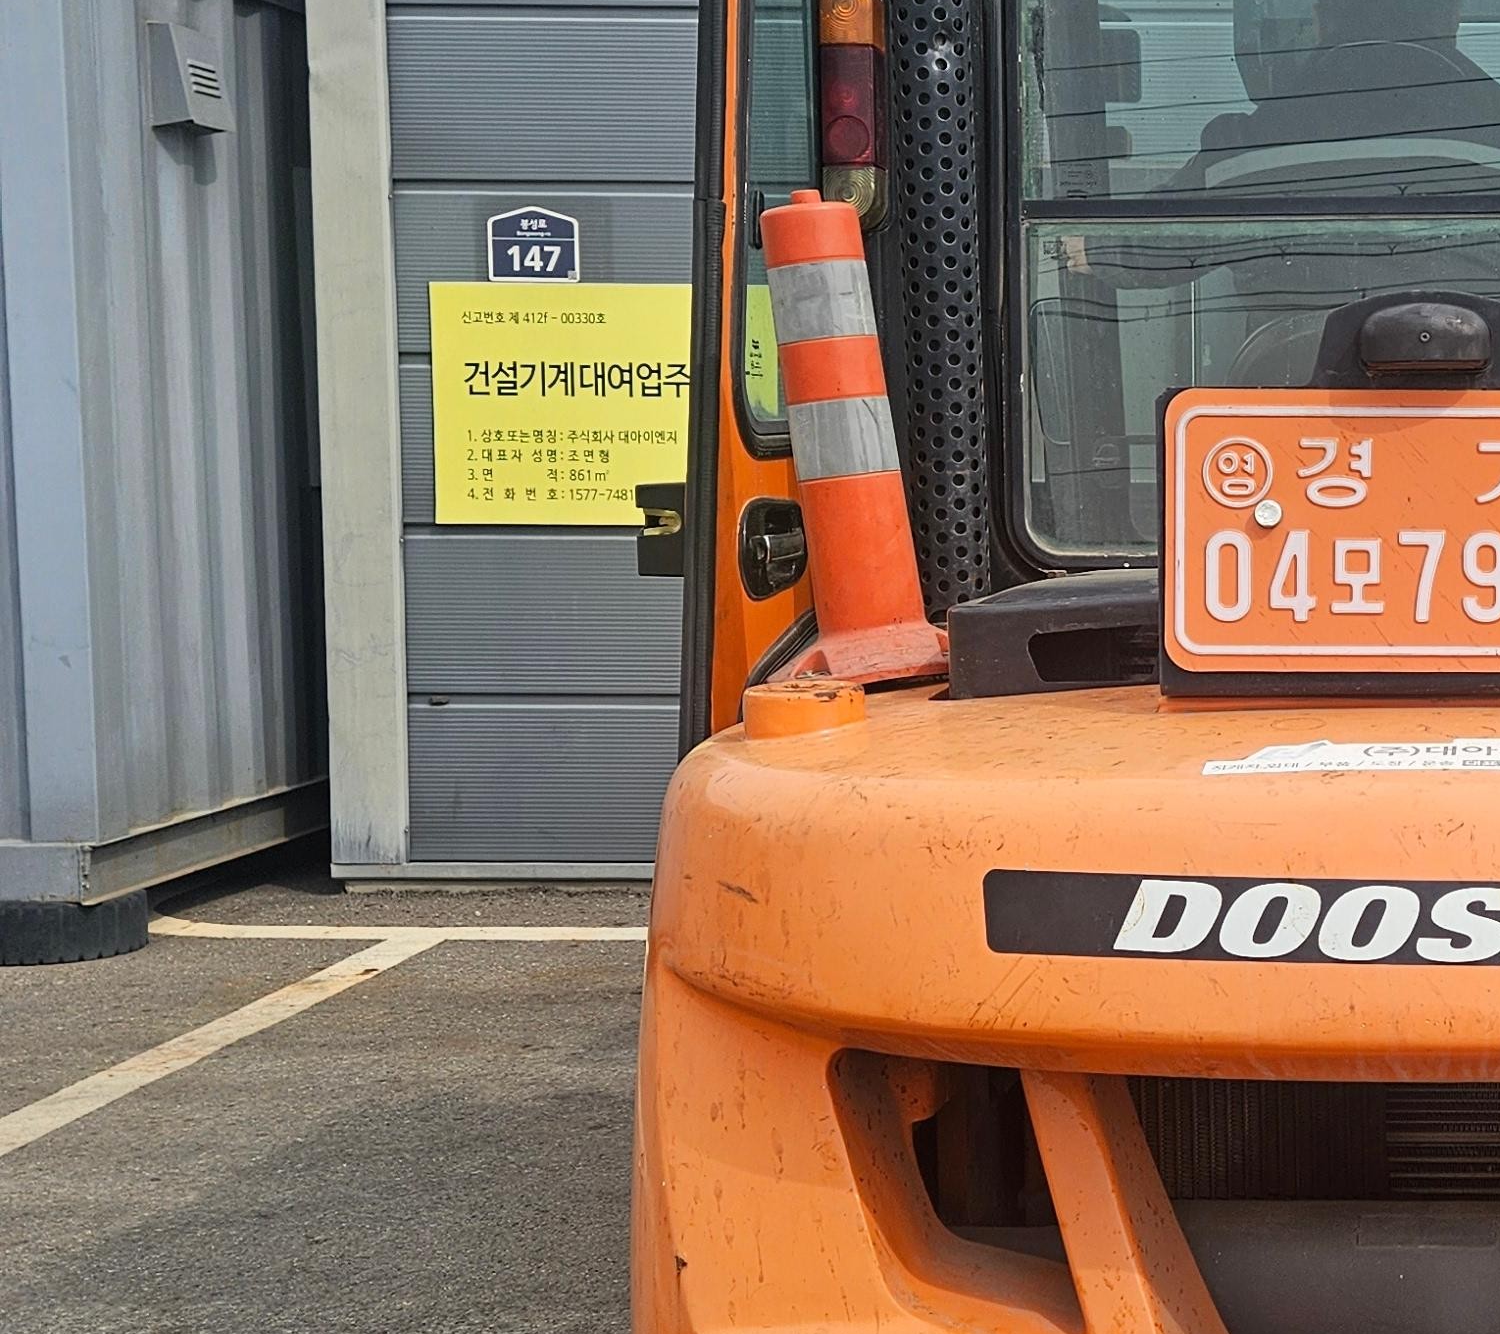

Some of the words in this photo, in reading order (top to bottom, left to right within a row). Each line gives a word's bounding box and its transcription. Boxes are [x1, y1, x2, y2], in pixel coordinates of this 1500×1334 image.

[506, 245, 562, 272] 147
[461, 310, 506, 325] 신고번호
[508, 310, 520, 325] 제
[560, 312, 607, 325] 00330호
[567, 429, 615, 445] 주식회사
[618, 429, 678, 446] 대아이엔지
[569, 487, 634, 503] 1577-7481
